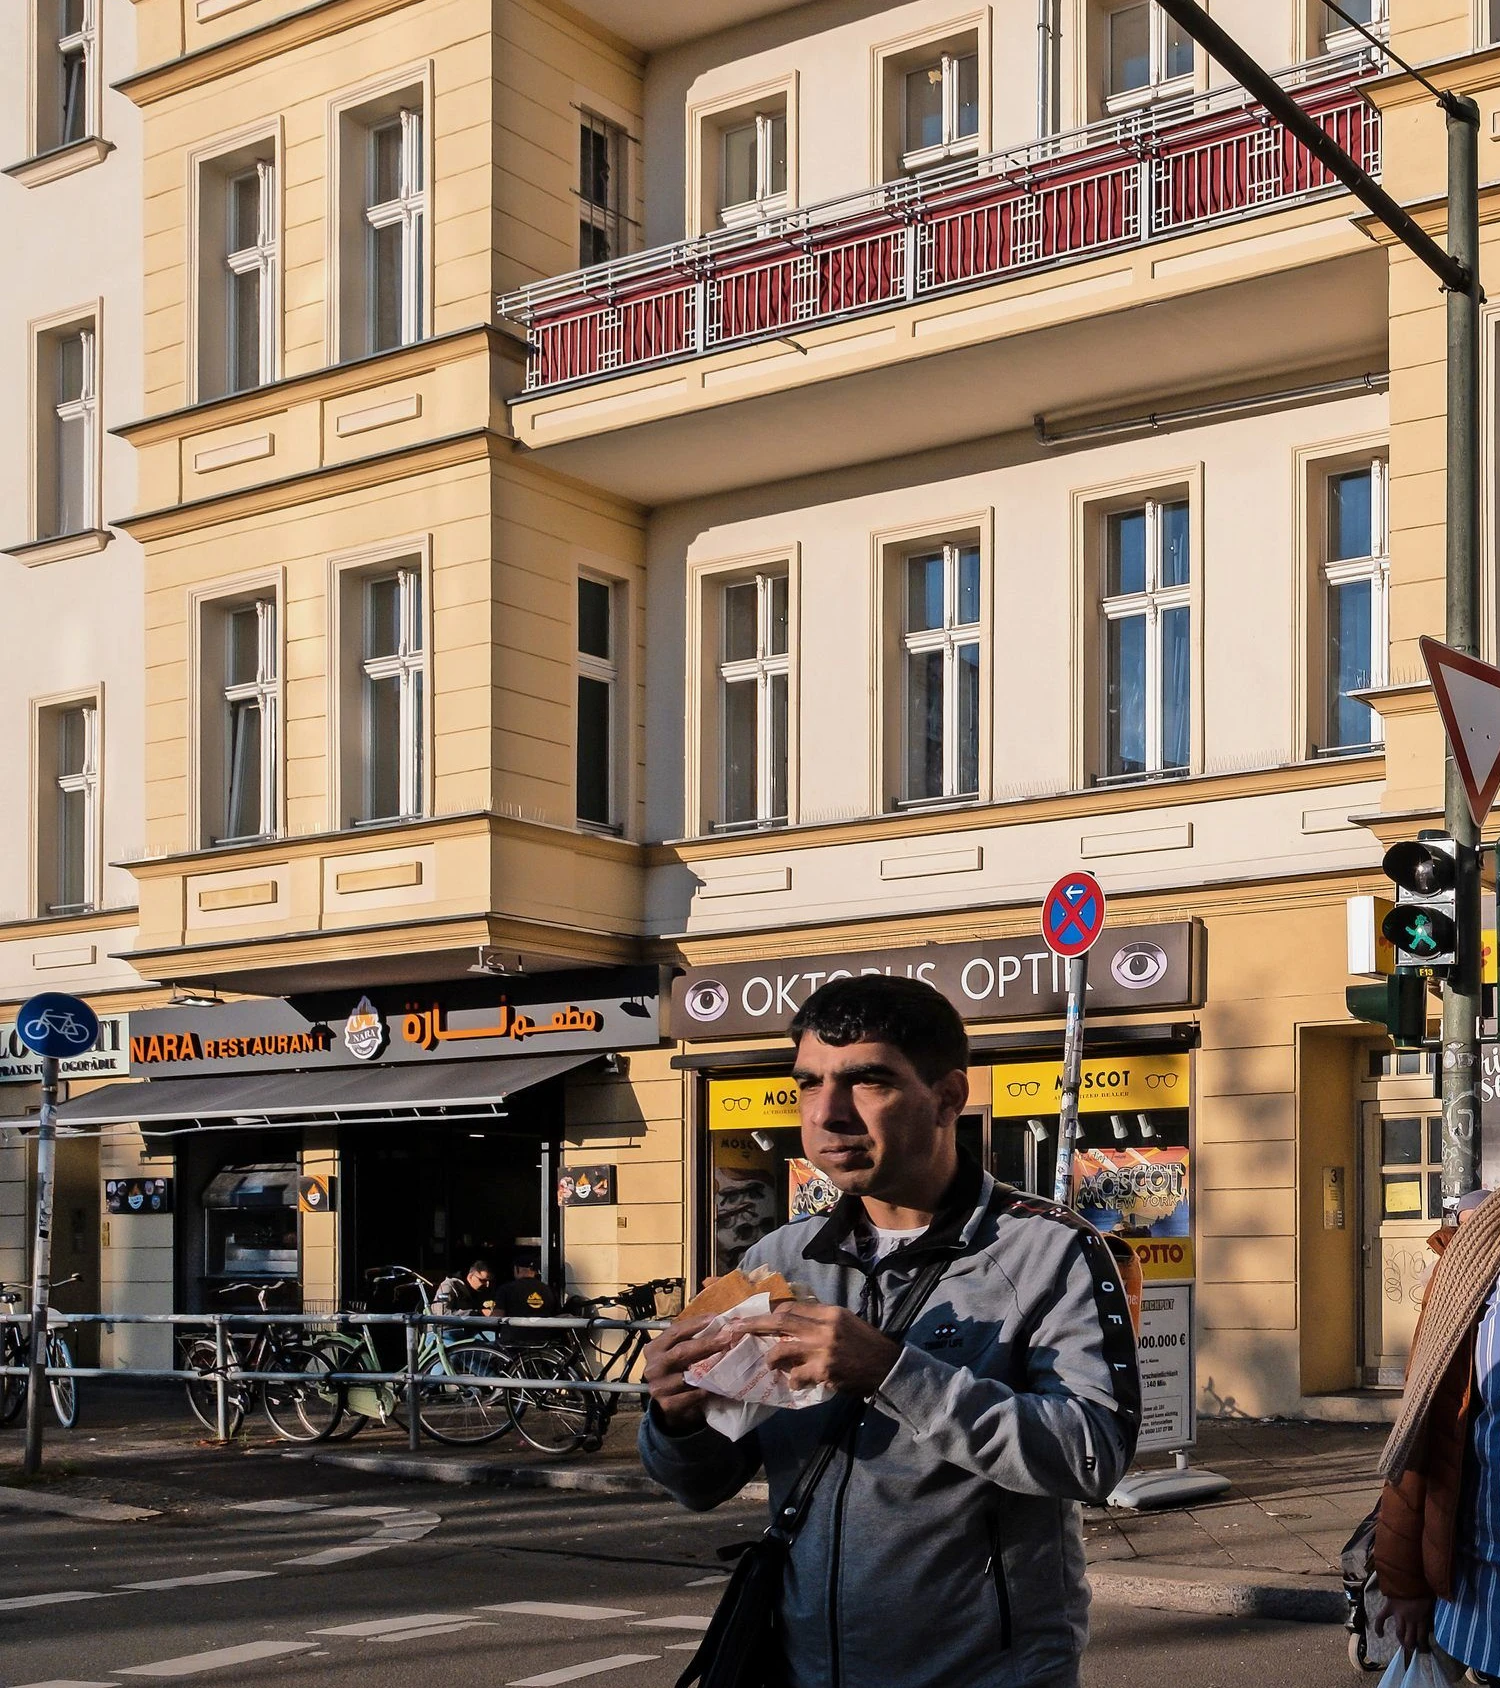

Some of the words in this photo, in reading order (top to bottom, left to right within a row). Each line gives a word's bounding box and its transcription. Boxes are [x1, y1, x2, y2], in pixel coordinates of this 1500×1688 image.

[1419, 968, 1434, 977] F13
[352, 1029, 375, 1043] NARA
[129, 1032, 197, 1063] NARA
[204, 1032, 324, 1058] RESTAURANT
[1054, 1070, 1131, 1091] MSCOT
[1330, 1168, 1338, 1183] 3
[1105, 1196, 1136, 1211] NEW
[1140, 1195, 1177, 1208] YORK
[1136, 1244, 1184, 1264] OTTO
[1179, 1332, 1186, 1346] €
